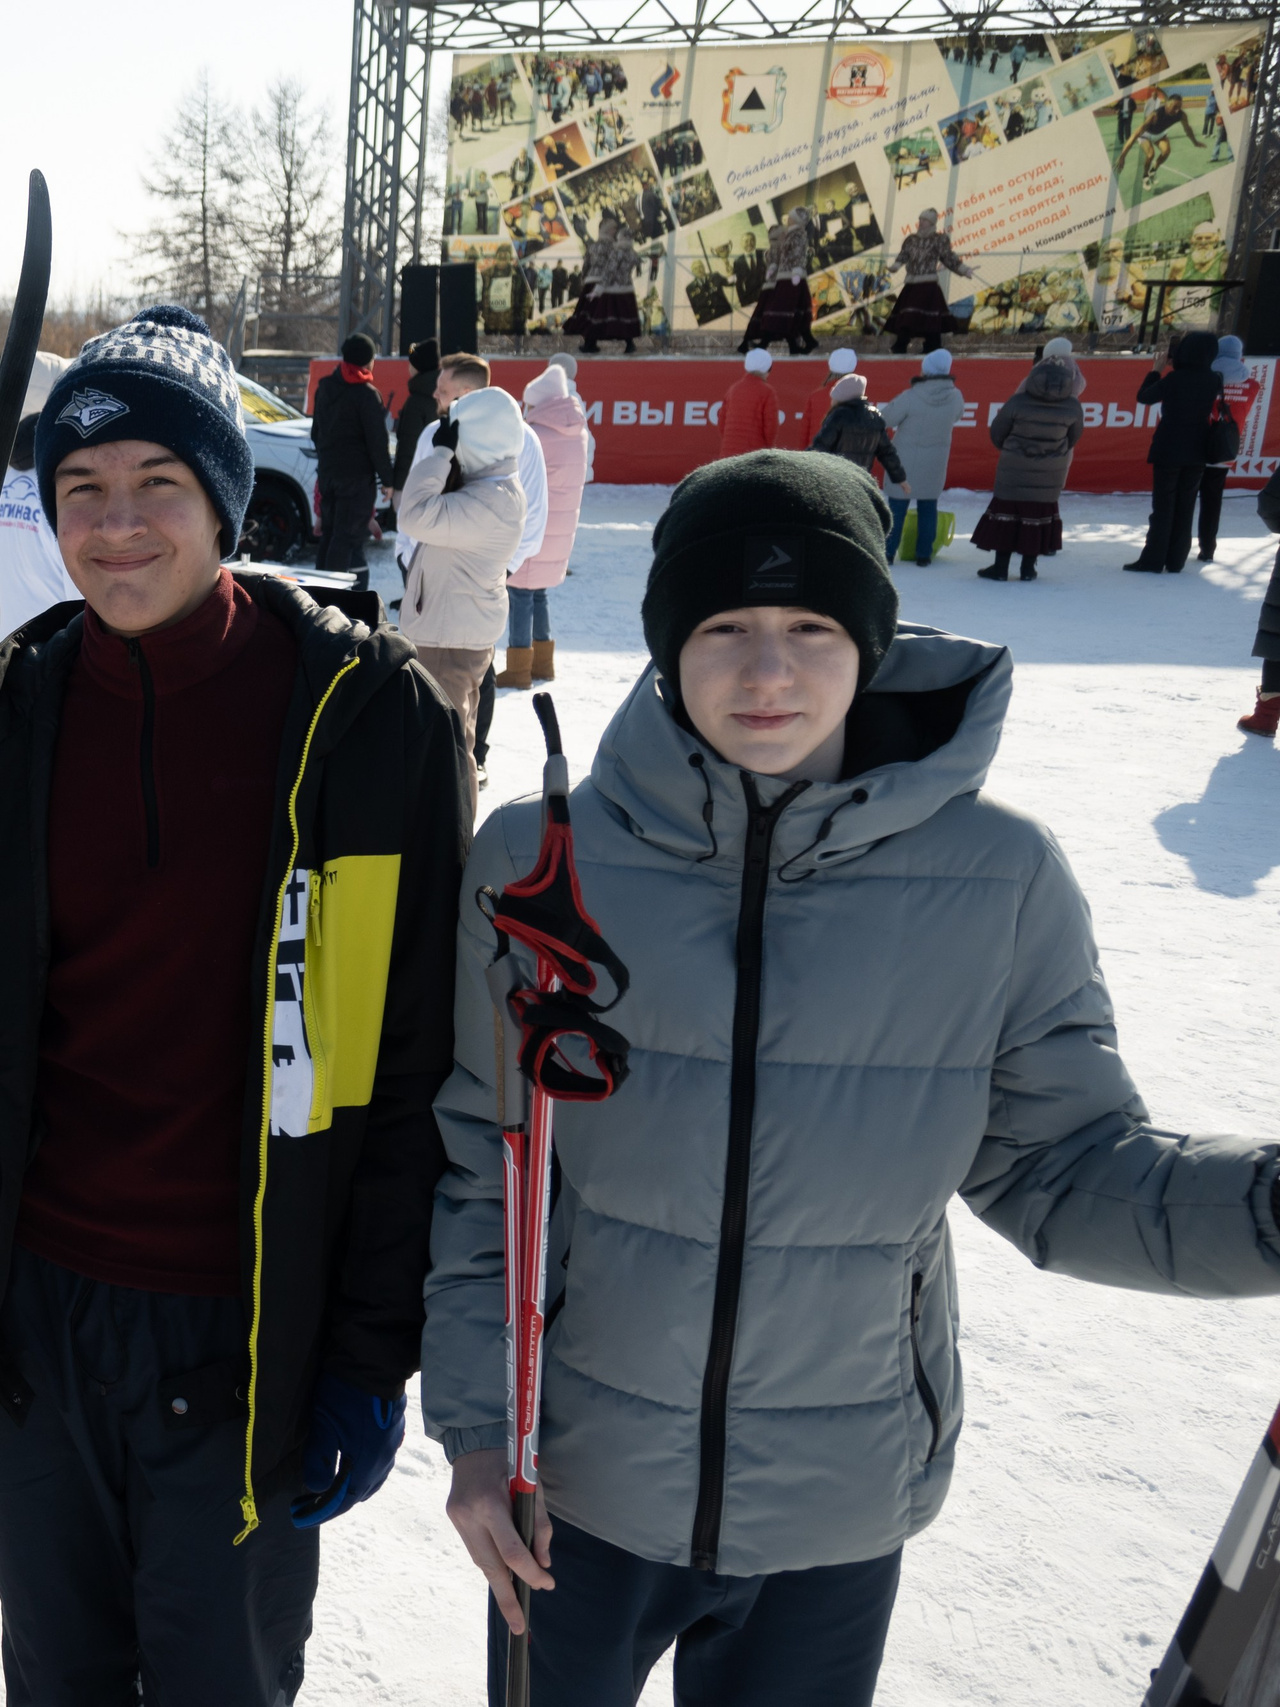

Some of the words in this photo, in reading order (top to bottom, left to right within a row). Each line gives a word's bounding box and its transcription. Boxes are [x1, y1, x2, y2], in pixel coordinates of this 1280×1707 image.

[956, 191, 986, 211] тебя
[988, 182, 1005, 197] не
[1008, 158, 1064, 188] остудит,
[989, 218, 1006, 232] не
[1009, 192, 1065, 223] старятся
[1068, 173, 1108, 198] люди,
[957, 206, 995, 228] годов
[1009, 192, 1025, 205] не
[983, 233, 1015, 252] сама
[1018, 204, 1072, 238] молода!
[1035, 207, 1117, 250] Кондратковская
[612, 401, 674, 426] ВЫ
